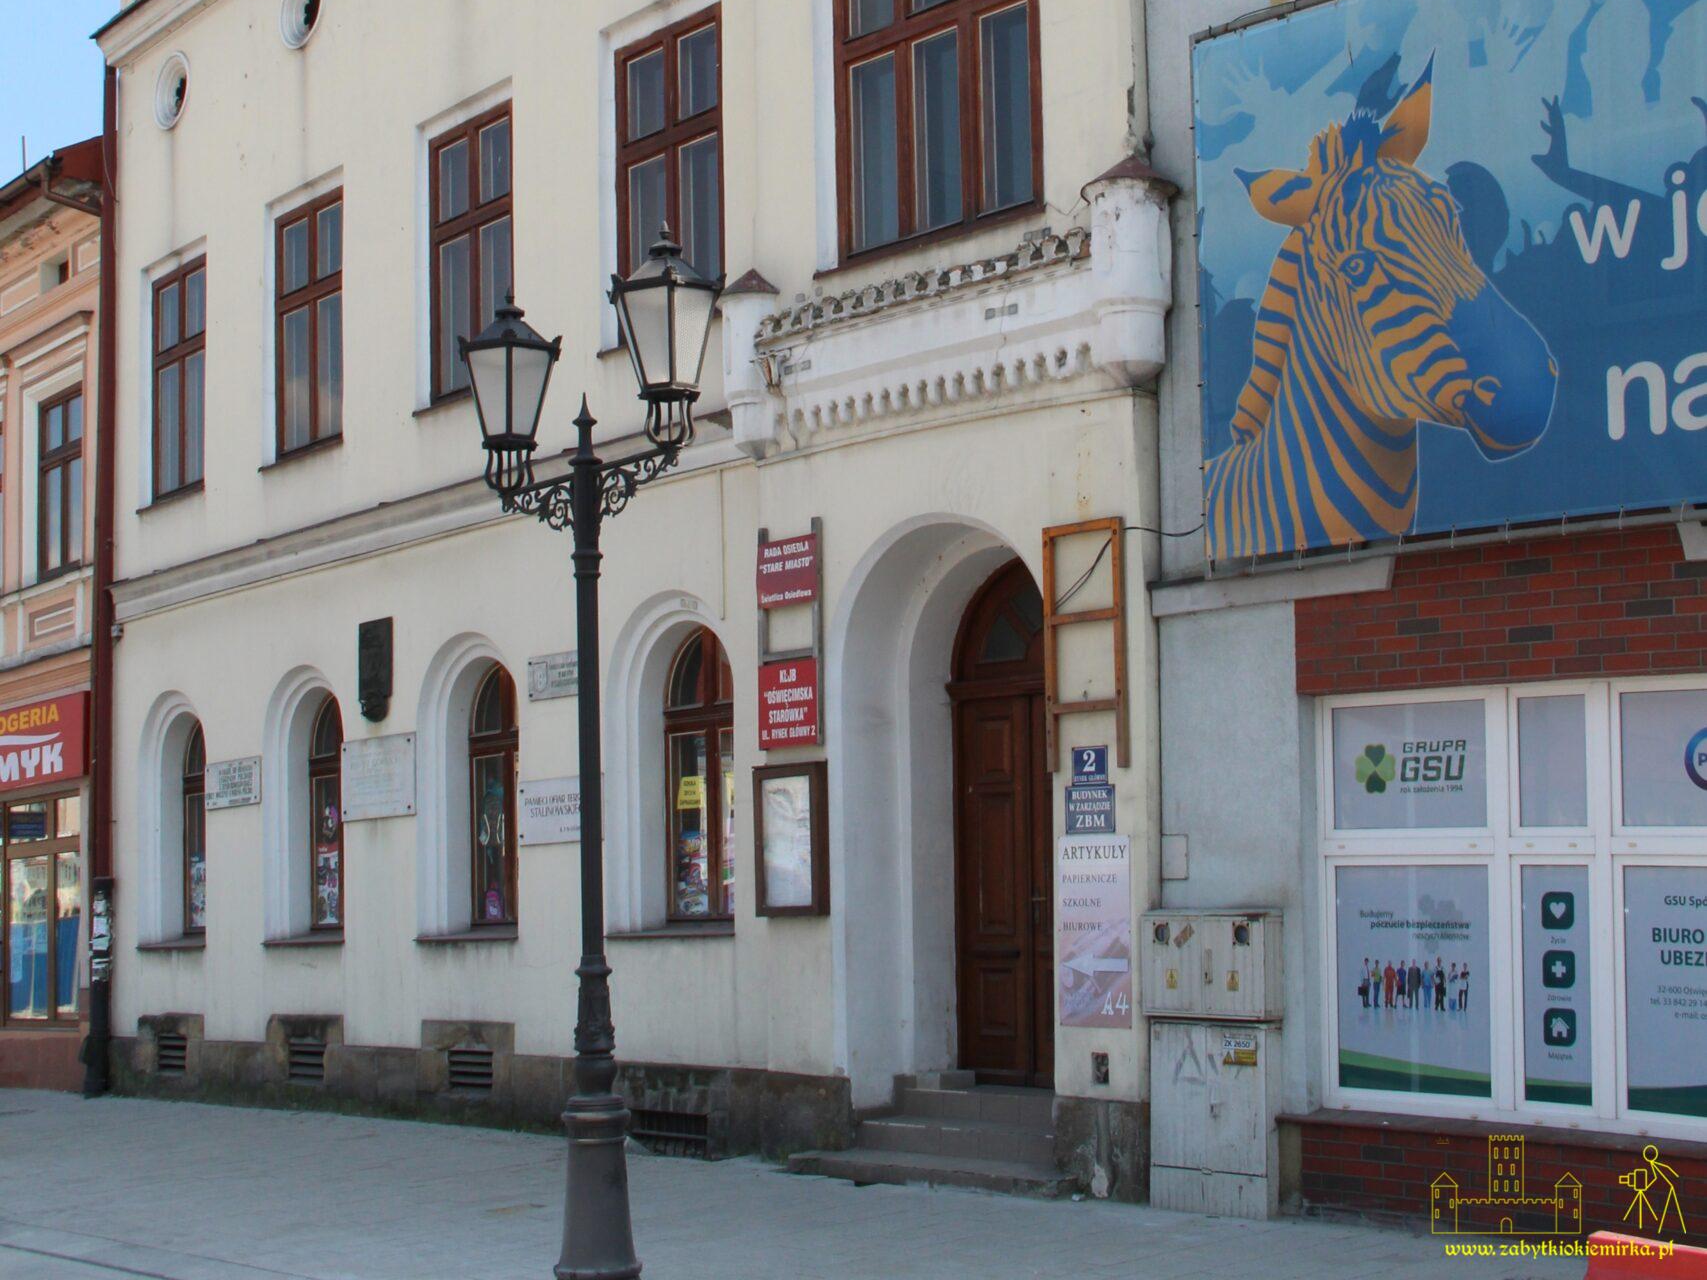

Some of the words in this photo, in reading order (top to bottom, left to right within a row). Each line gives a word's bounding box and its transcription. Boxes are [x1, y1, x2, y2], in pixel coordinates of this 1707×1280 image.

[1569, 198, 1641, 264] w
[1660, 170, 1707, 271] j
[1606, 351, 1707, 441] na
[764, 547, 782, 558] RADA
[783, 541, 809, 555] OSIEDLA
[772, 728, 788, 739] RYNEK
[811, 725, 816, 736] 2
[1402, 739, 1467, 754] GRUPA
[1082, 750, 1096, 772] 2
[1400, 754, 1465, 782] GSU
[1072, 789, 1108, 800] BUDYNEK
[1446, 783, 1463, 792] 1994
[1069, 803, 1075, 812] W
[1076, 813, 1105, 828] ZBM
[1062, 844, 1127, 860] ARTYKUŁY
[1062, 873, 1117, 883] PAPIERNICZE
[1062, 898, 1102, 907] SZKOLNE
[1664, 895, 1686, 906] GSU
[1063, 921, 1102, 931] BIUROWE
[1370, 920, 1405, 930] poczucie
[1651, 927, 1705, 944] BIURO
[1660, 950, 1707, 966] UBEZ
